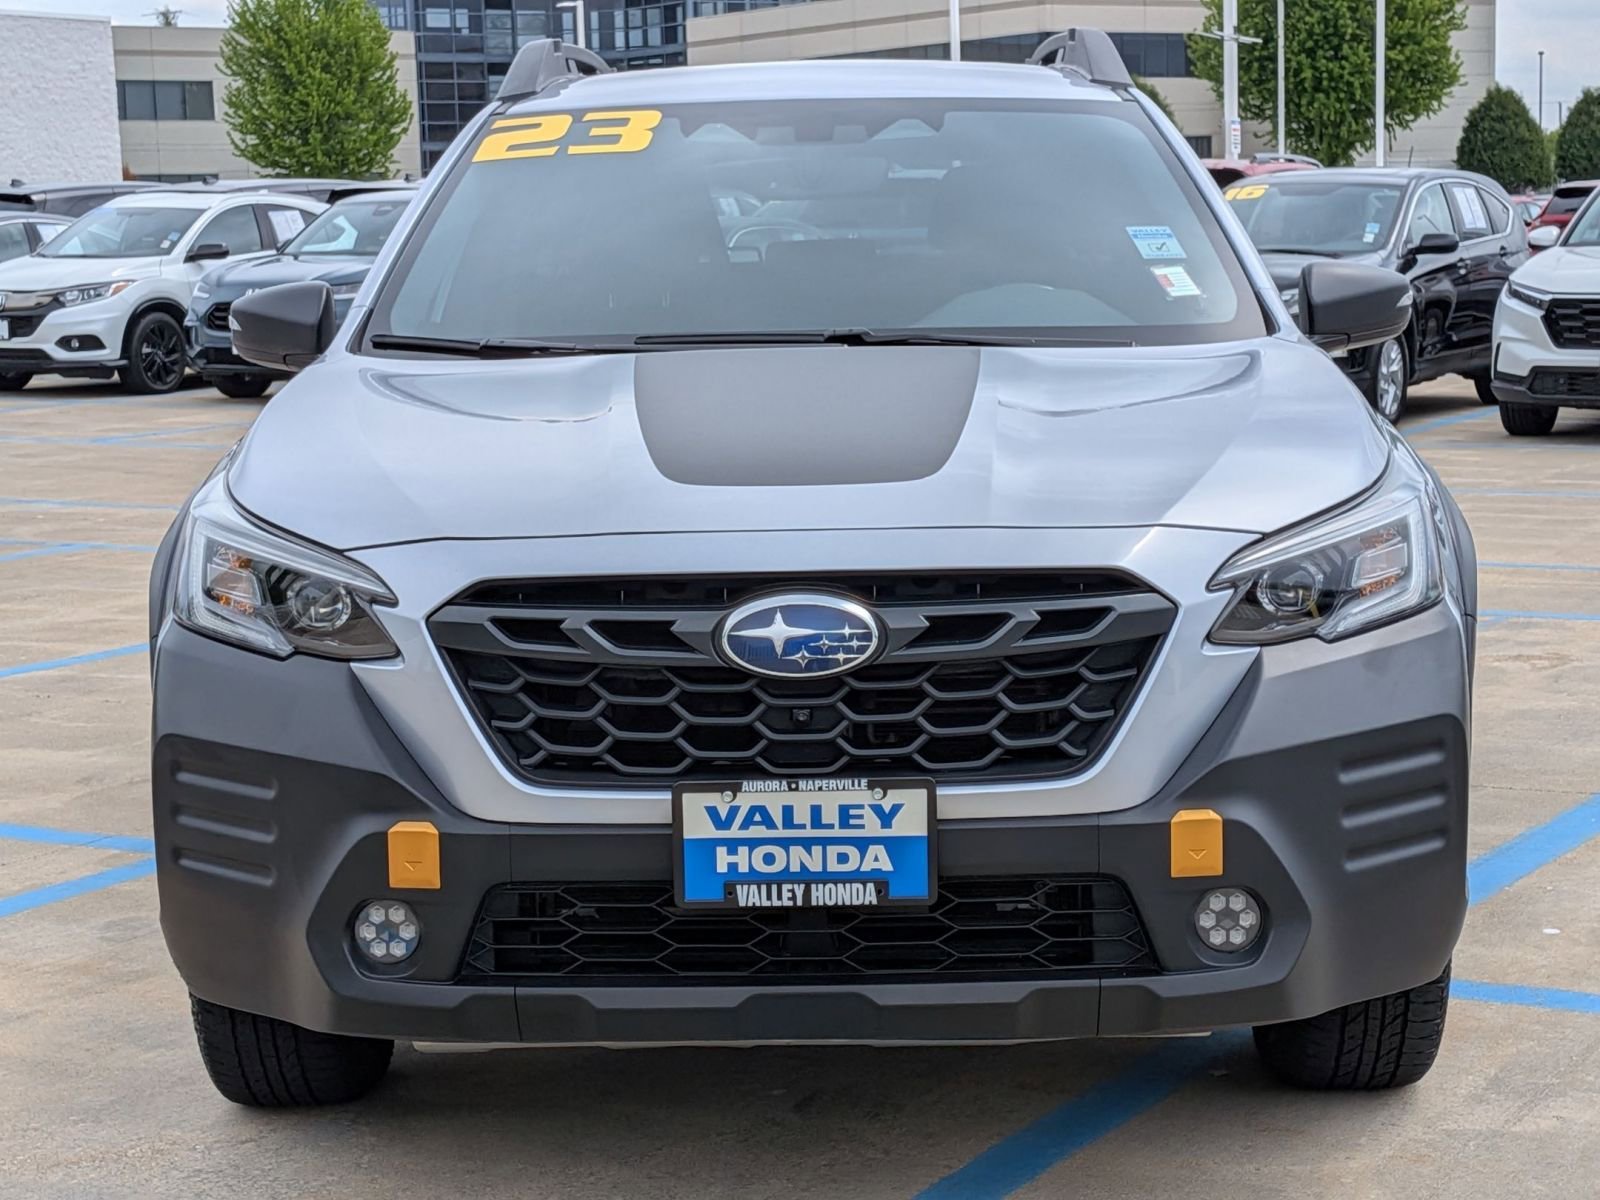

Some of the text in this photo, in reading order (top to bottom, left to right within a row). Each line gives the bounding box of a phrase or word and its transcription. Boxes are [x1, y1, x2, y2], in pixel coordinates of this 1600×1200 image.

[472, 110, 662, 162] 23
[1225, 185, 1269, 200] 16
[741, 778, 868, 793] AURORA NAPERVILLE
[704, 803, 905, 831] VALLEY
[716, 845, 894, 873] HONDA
[736, 882, 878, 907] VALLEY HONDA
